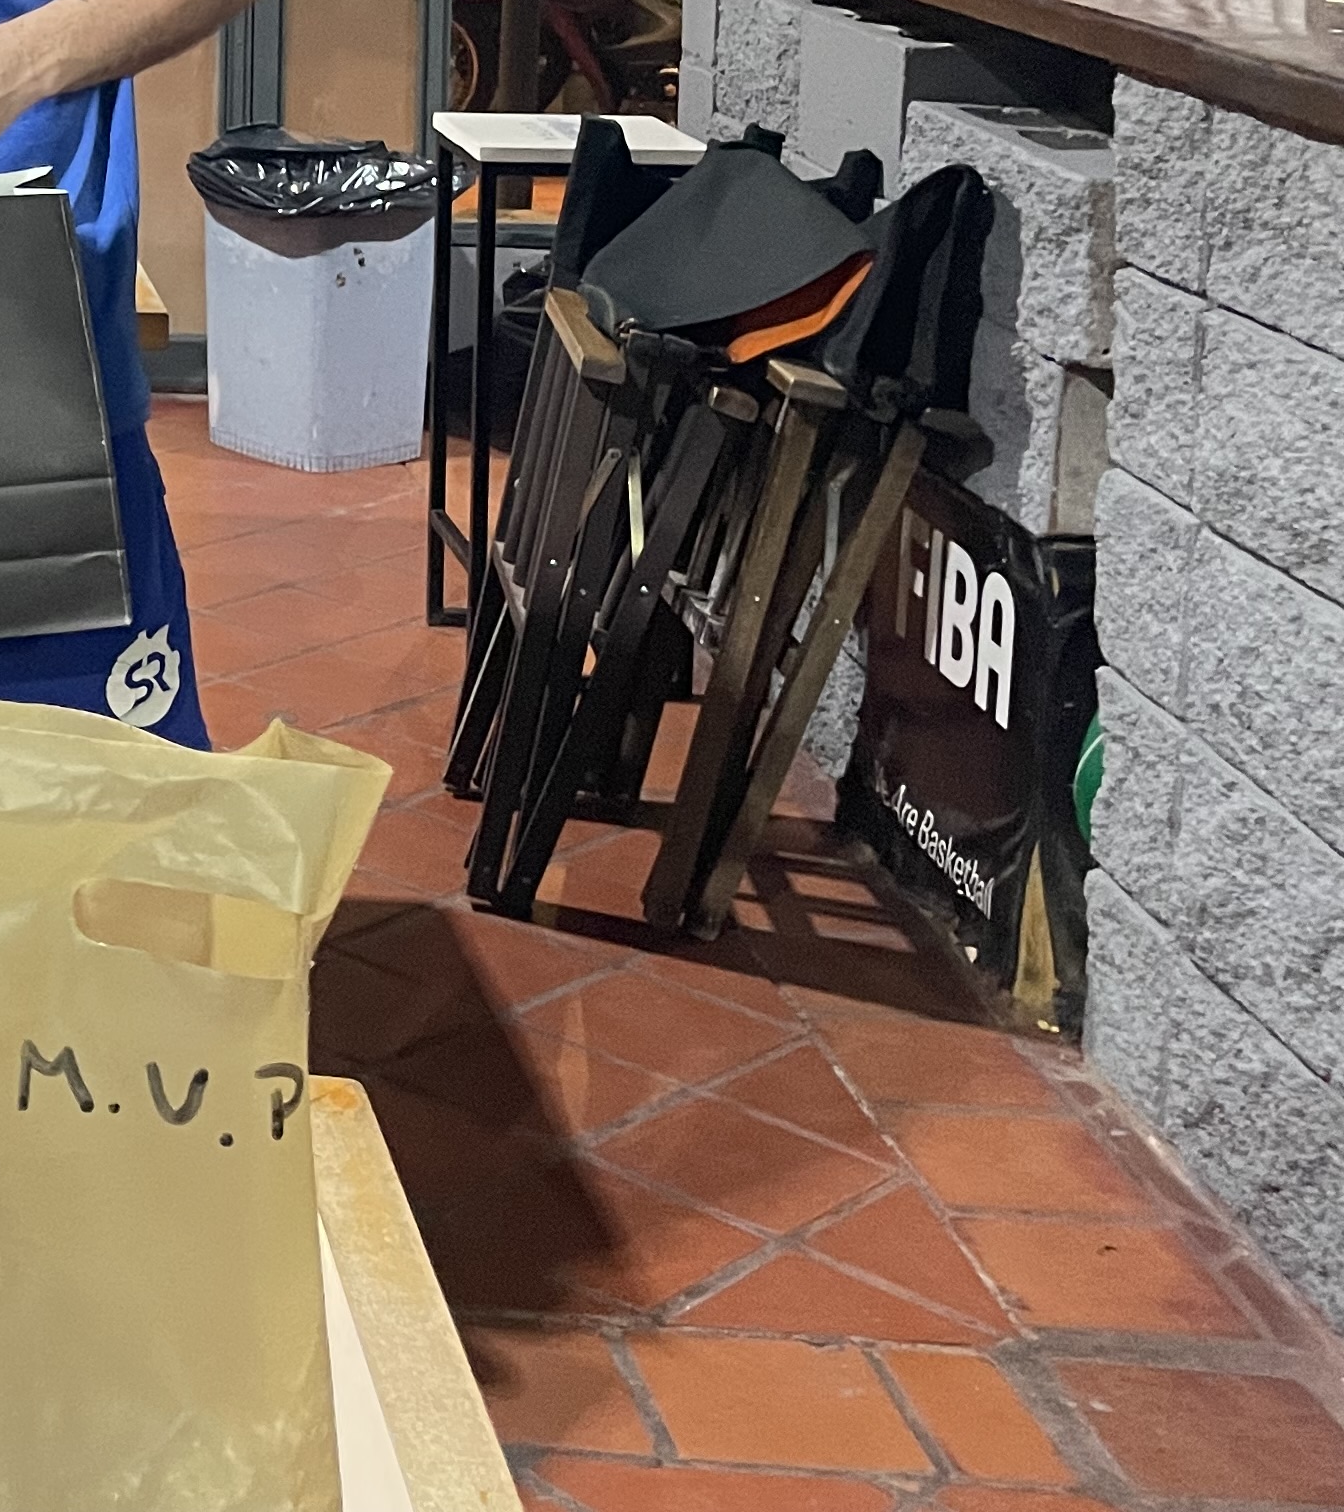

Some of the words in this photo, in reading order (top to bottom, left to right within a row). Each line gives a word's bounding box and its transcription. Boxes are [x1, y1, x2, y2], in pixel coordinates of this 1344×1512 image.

[895, 504, 1016, 731] FIBA
[890, 783, 919, 837] Are
[917, 808, 996, 921] Basketball
